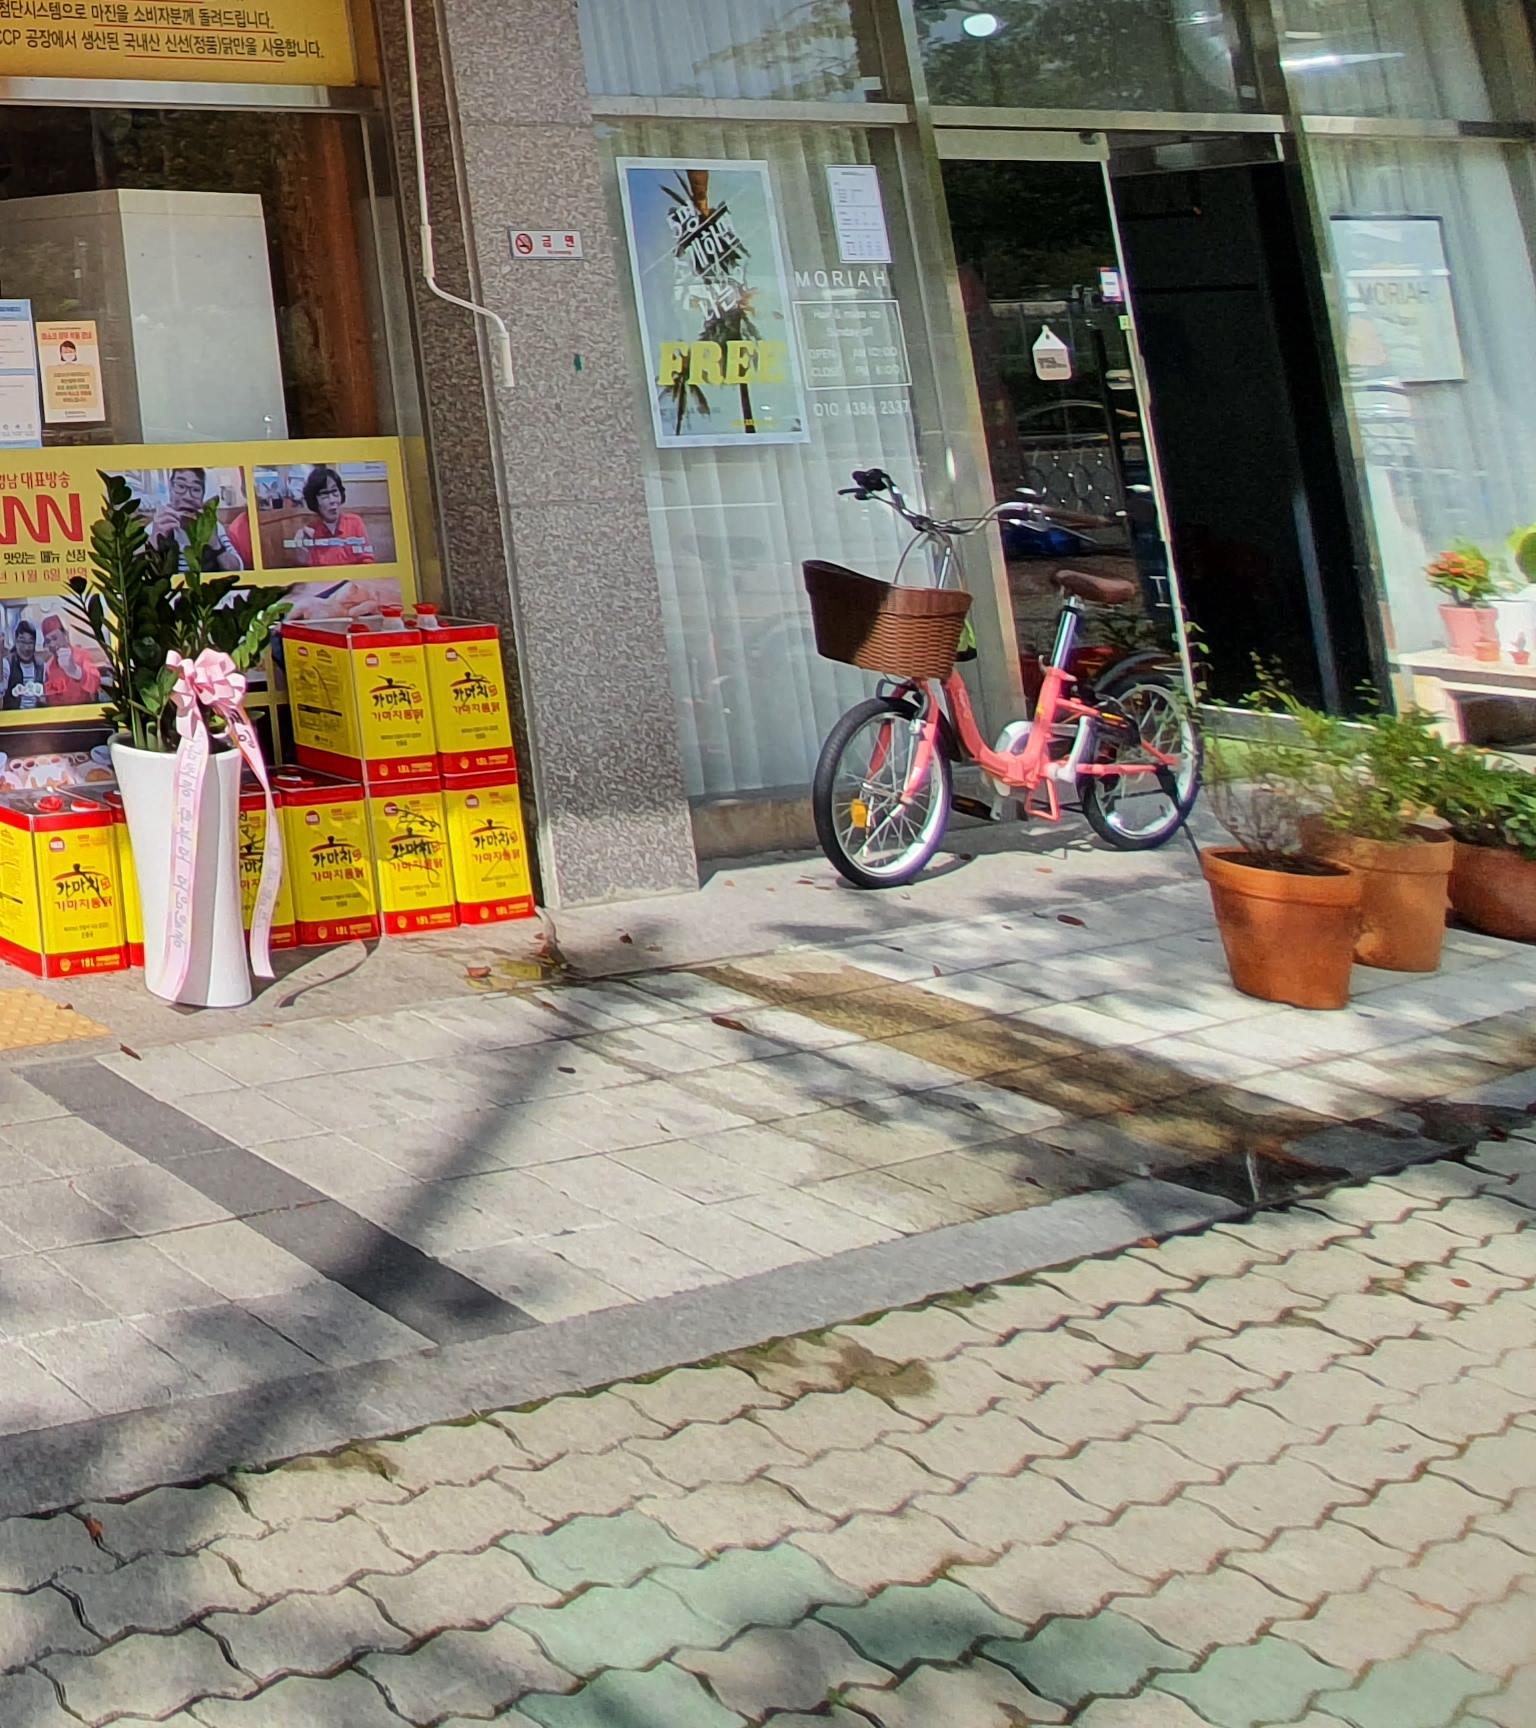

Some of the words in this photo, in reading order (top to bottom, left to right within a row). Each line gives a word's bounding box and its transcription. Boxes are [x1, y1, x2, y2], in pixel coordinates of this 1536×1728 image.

[91, 4, 129, 23] 마진을
[134, 6, 195, 25] 소비자분께
[25, 29, 77, 49] 공장에서
[81, 31, 120, 51] 생산된
[123, 32, 160, 51] 국내산
[795, 271, 886, 287] MORIAH
[657, 340, 788, 386] FREE
[813, 403, 839, 416] 010
[880, 400, 909, 414] 2337
[21, 471, 70, 488] 대표방송
[14, 570, 38, 583] 11월
[313, 847, 353, 867] 가마치
